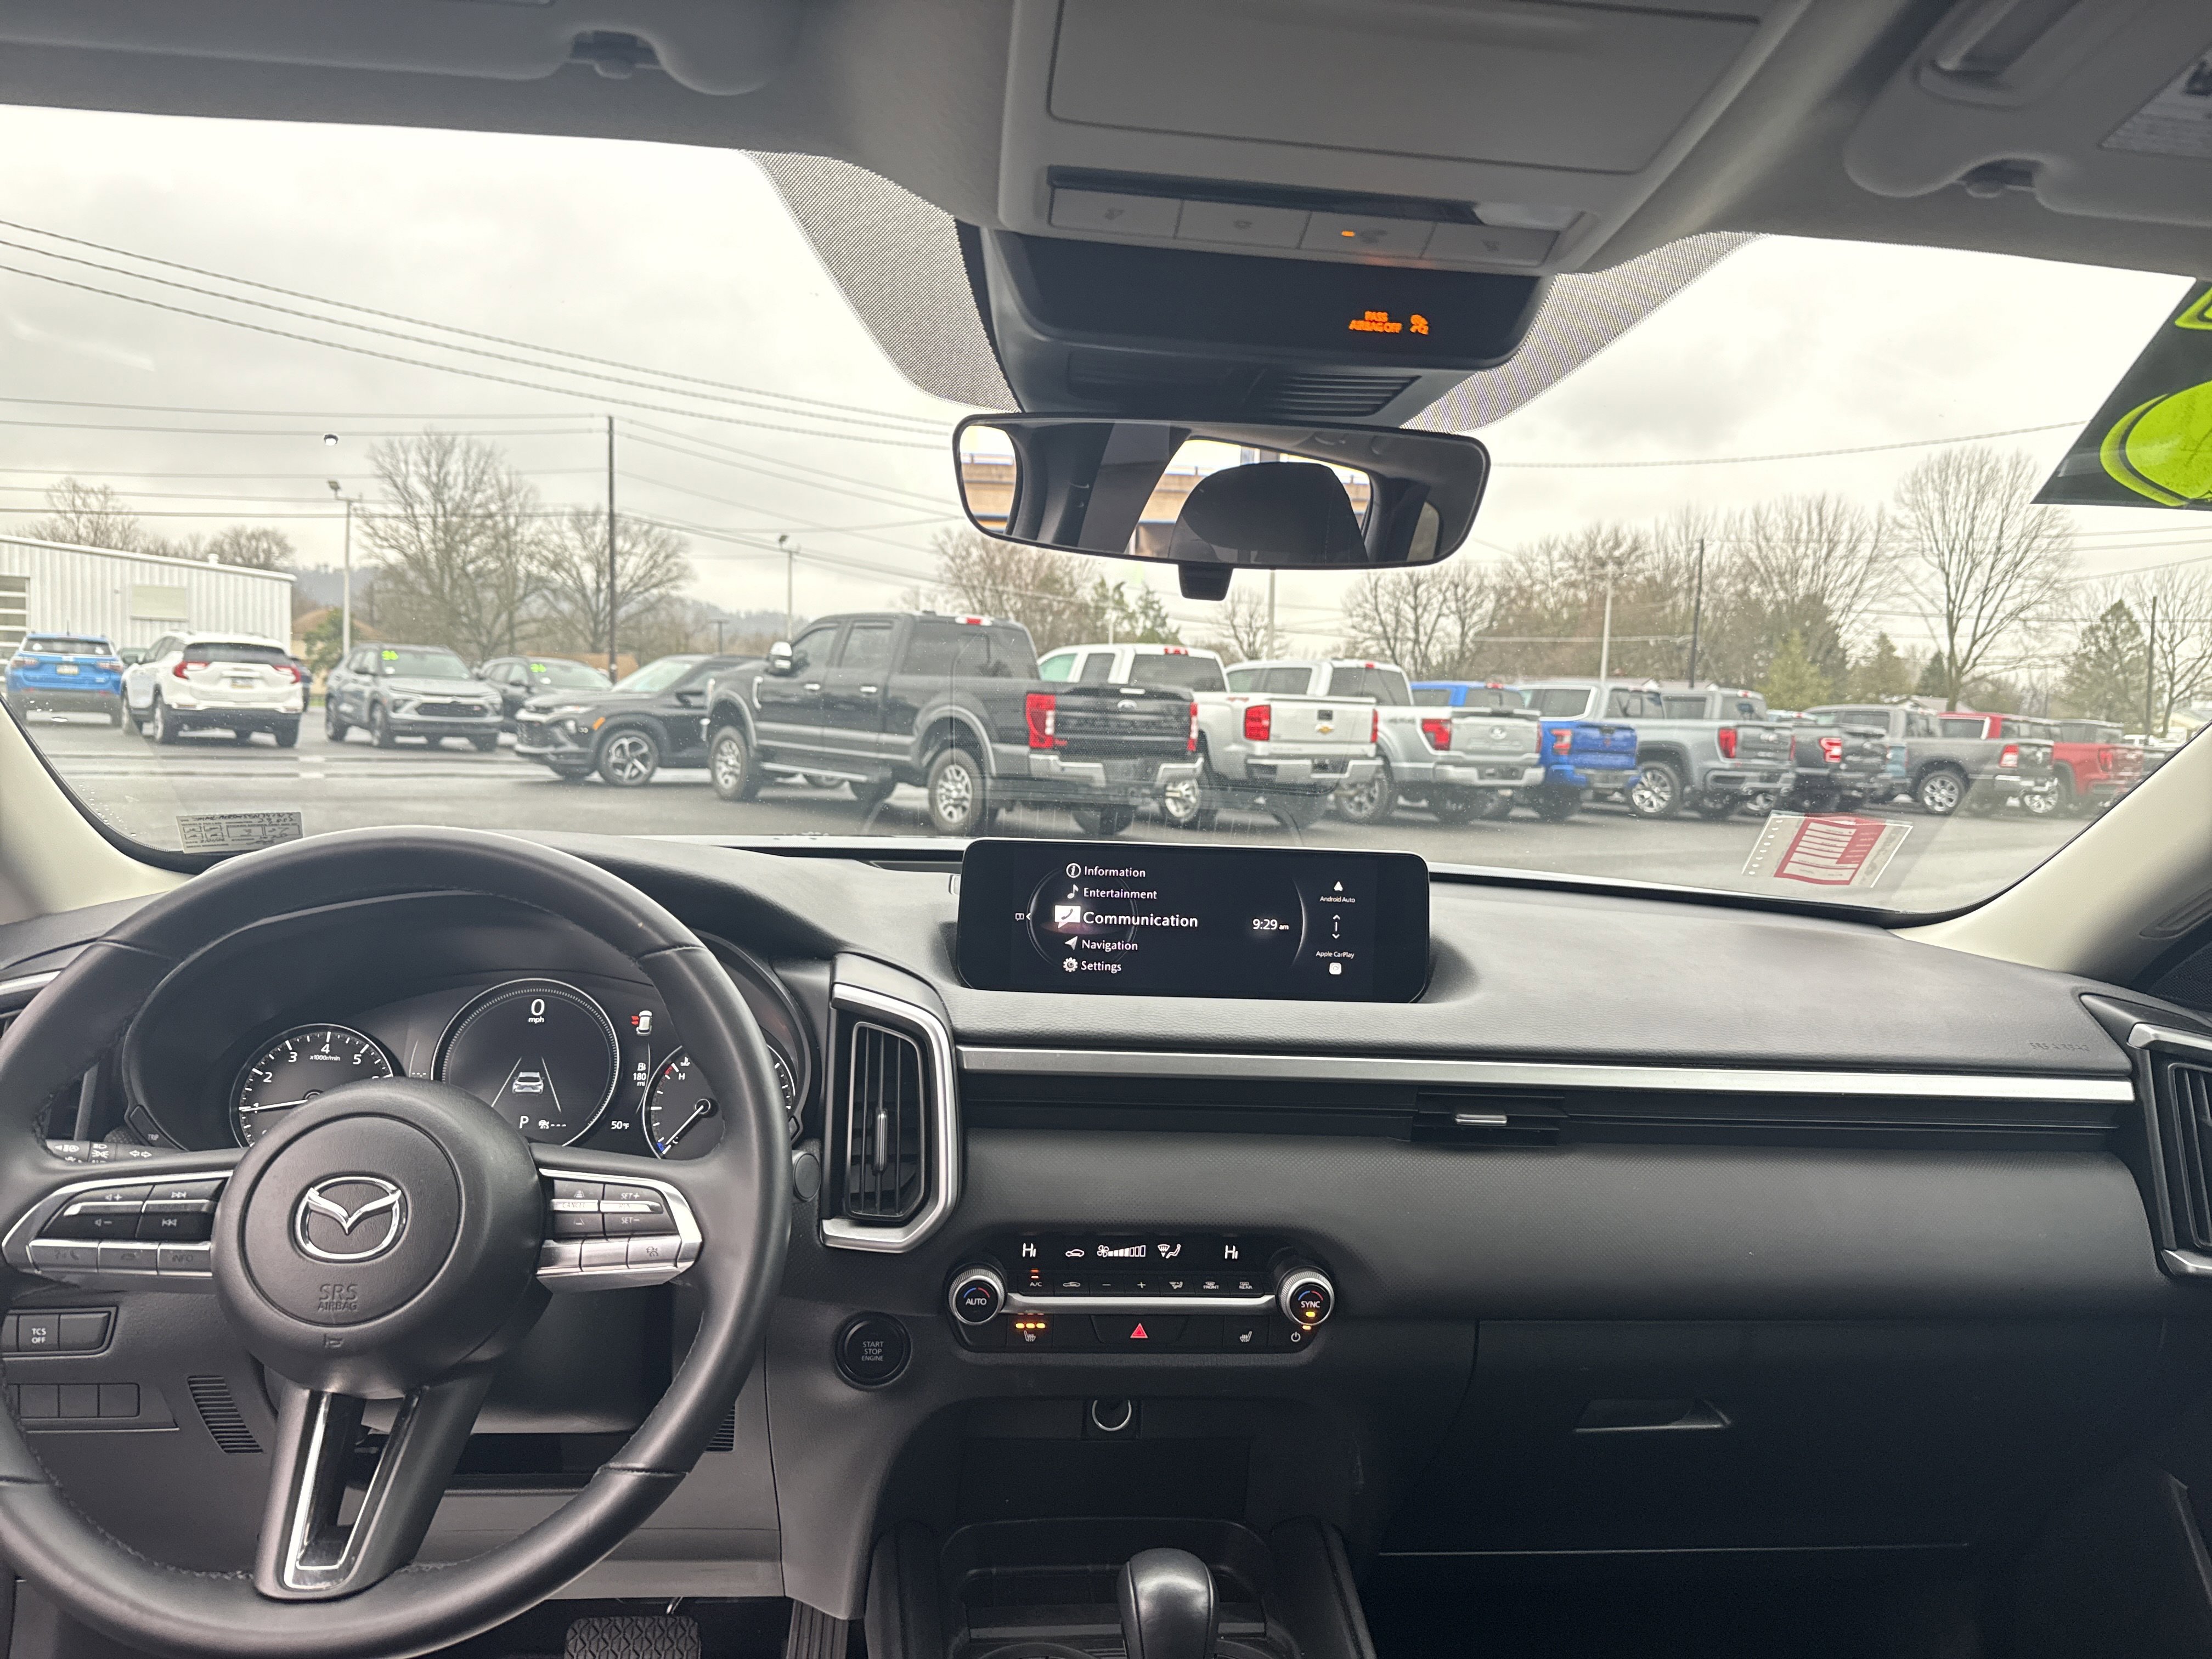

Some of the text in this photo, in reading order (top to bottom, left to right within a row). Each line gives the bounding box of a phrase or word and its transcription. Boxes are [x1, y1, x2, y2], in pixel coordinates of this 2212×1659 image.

[1084, 866, 1146, 878] Information
[1084, 887, 1158, 900] Entertainment
[1083, 911, 1198, 927] Communication
[1252, 918, 1278, 930] 9:29
[1082, 939, 1138, 952] Navigation
[1081, 961, 1122, 974] Settings
[531, 998, 545, 1015] 0
[321, 1043, 330, 1054] 4
[288, 1052, 298, 1063] 3
[352, 1054, 362, 1065] 5
[263, 1071, 273, 1083] 2
[633, 1073, 647, 1081] 180
[519, 1115, 529, 1129] P
[172, 1254, 194, 1262] INFO
[318, 1284, 358, 1301] SRS
[317, 1301, 358, 1311] AIRBAG
[1301, 1300, 1321, 1308] SYNC
